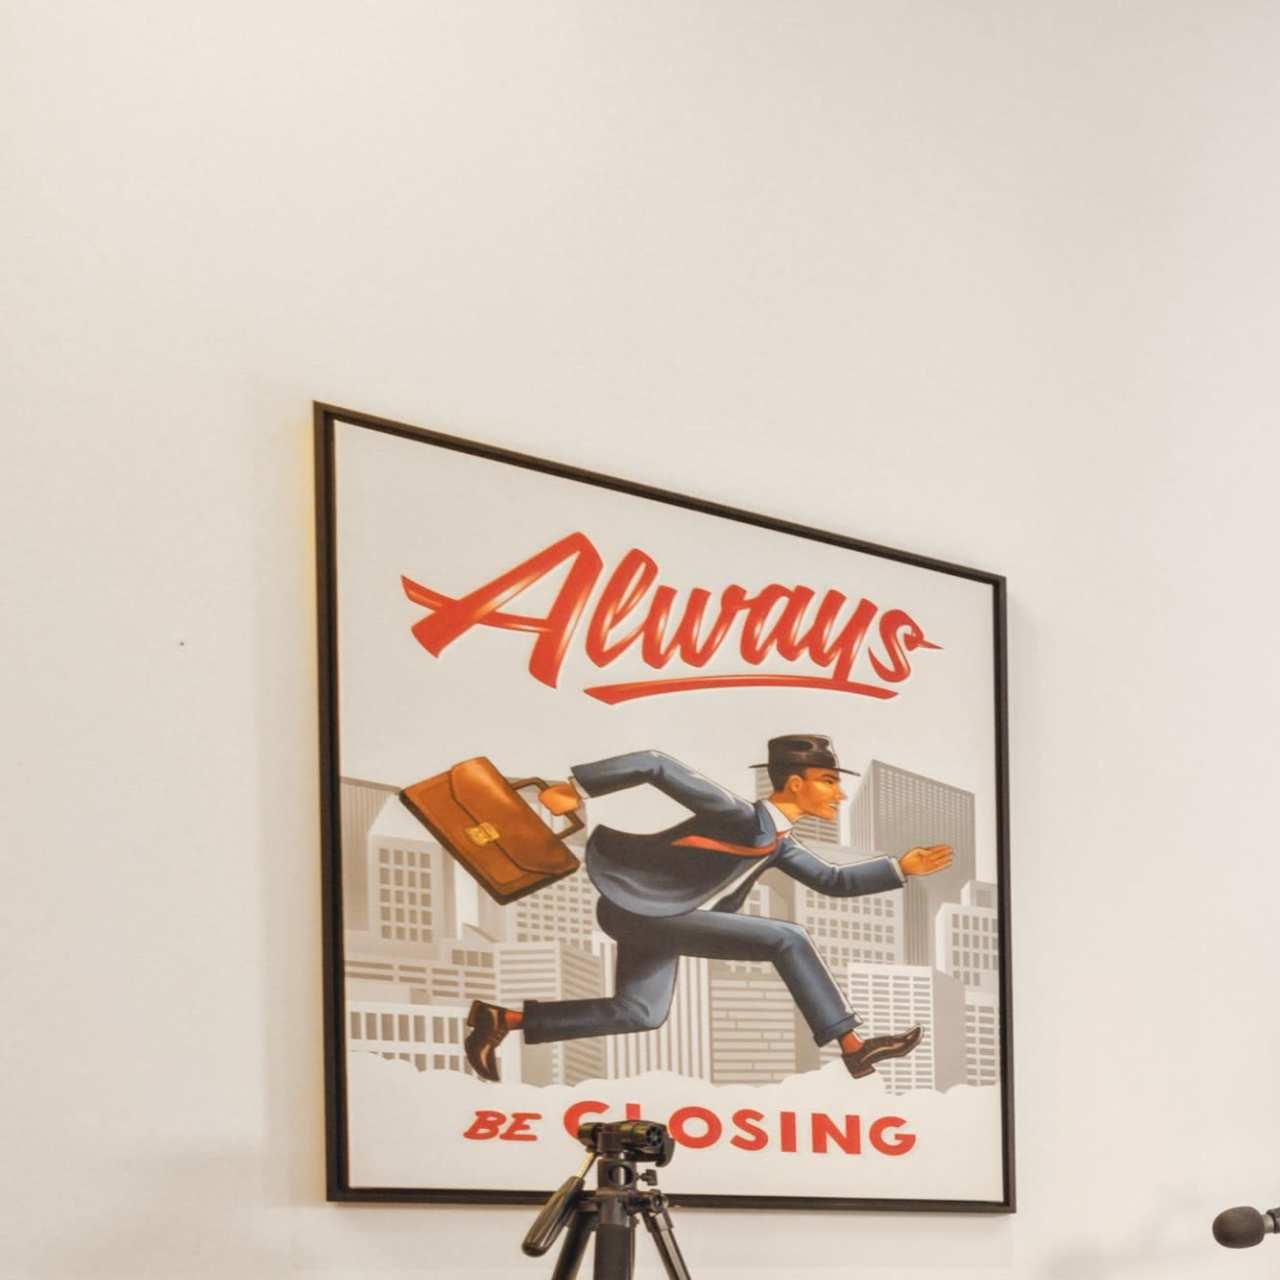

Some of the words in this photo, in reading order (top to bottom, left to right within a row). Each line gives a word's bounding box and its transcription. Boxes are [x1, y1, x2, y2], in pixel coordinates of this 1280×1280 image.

[401, 531, 943, 705] Always
[463, 1109, 543, 1142] BE
[563, 1100, 917, 1157] COSING
